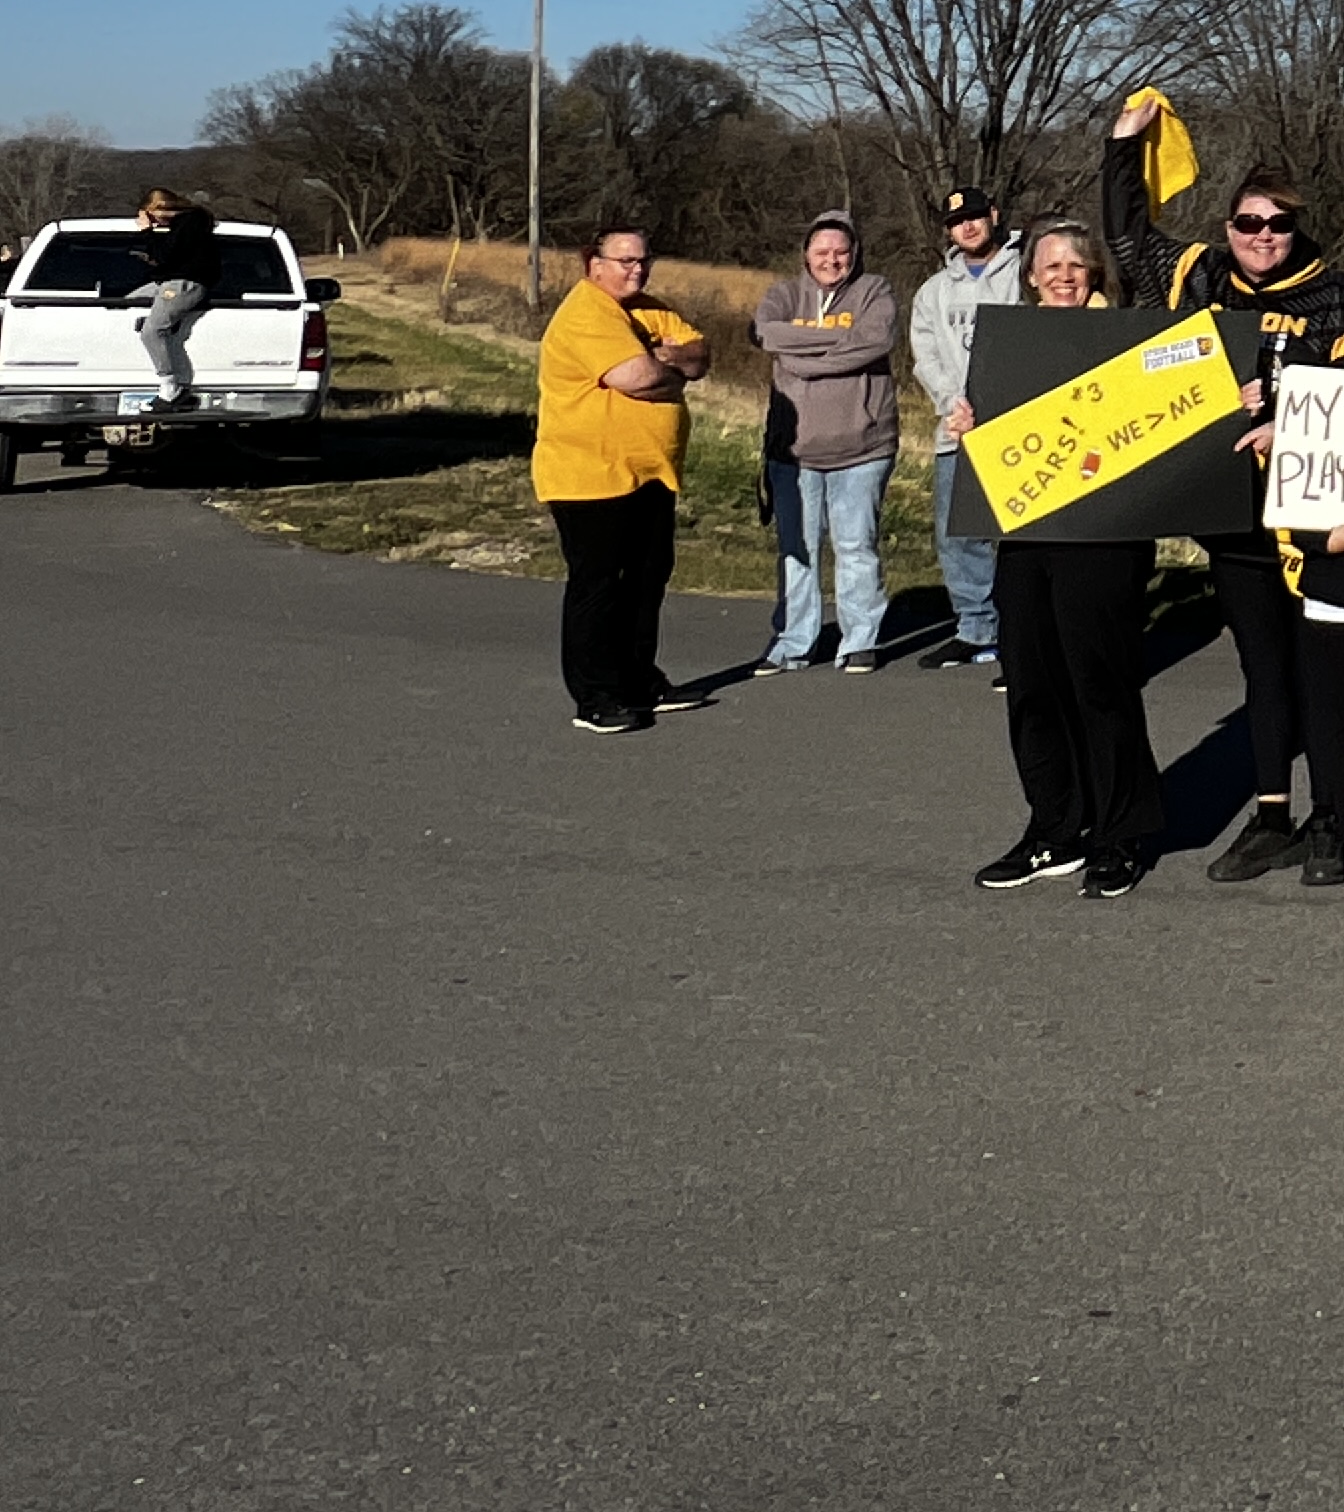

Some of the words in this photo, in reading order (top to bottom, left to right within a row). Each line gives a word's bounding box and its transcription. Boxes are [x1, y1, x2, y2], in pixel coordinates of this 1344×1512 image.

[1281, 385, 1343, 441] MY
[1001, 432, 1044, 469] GO
[1005, 416, 1086, 518] BEARS!
